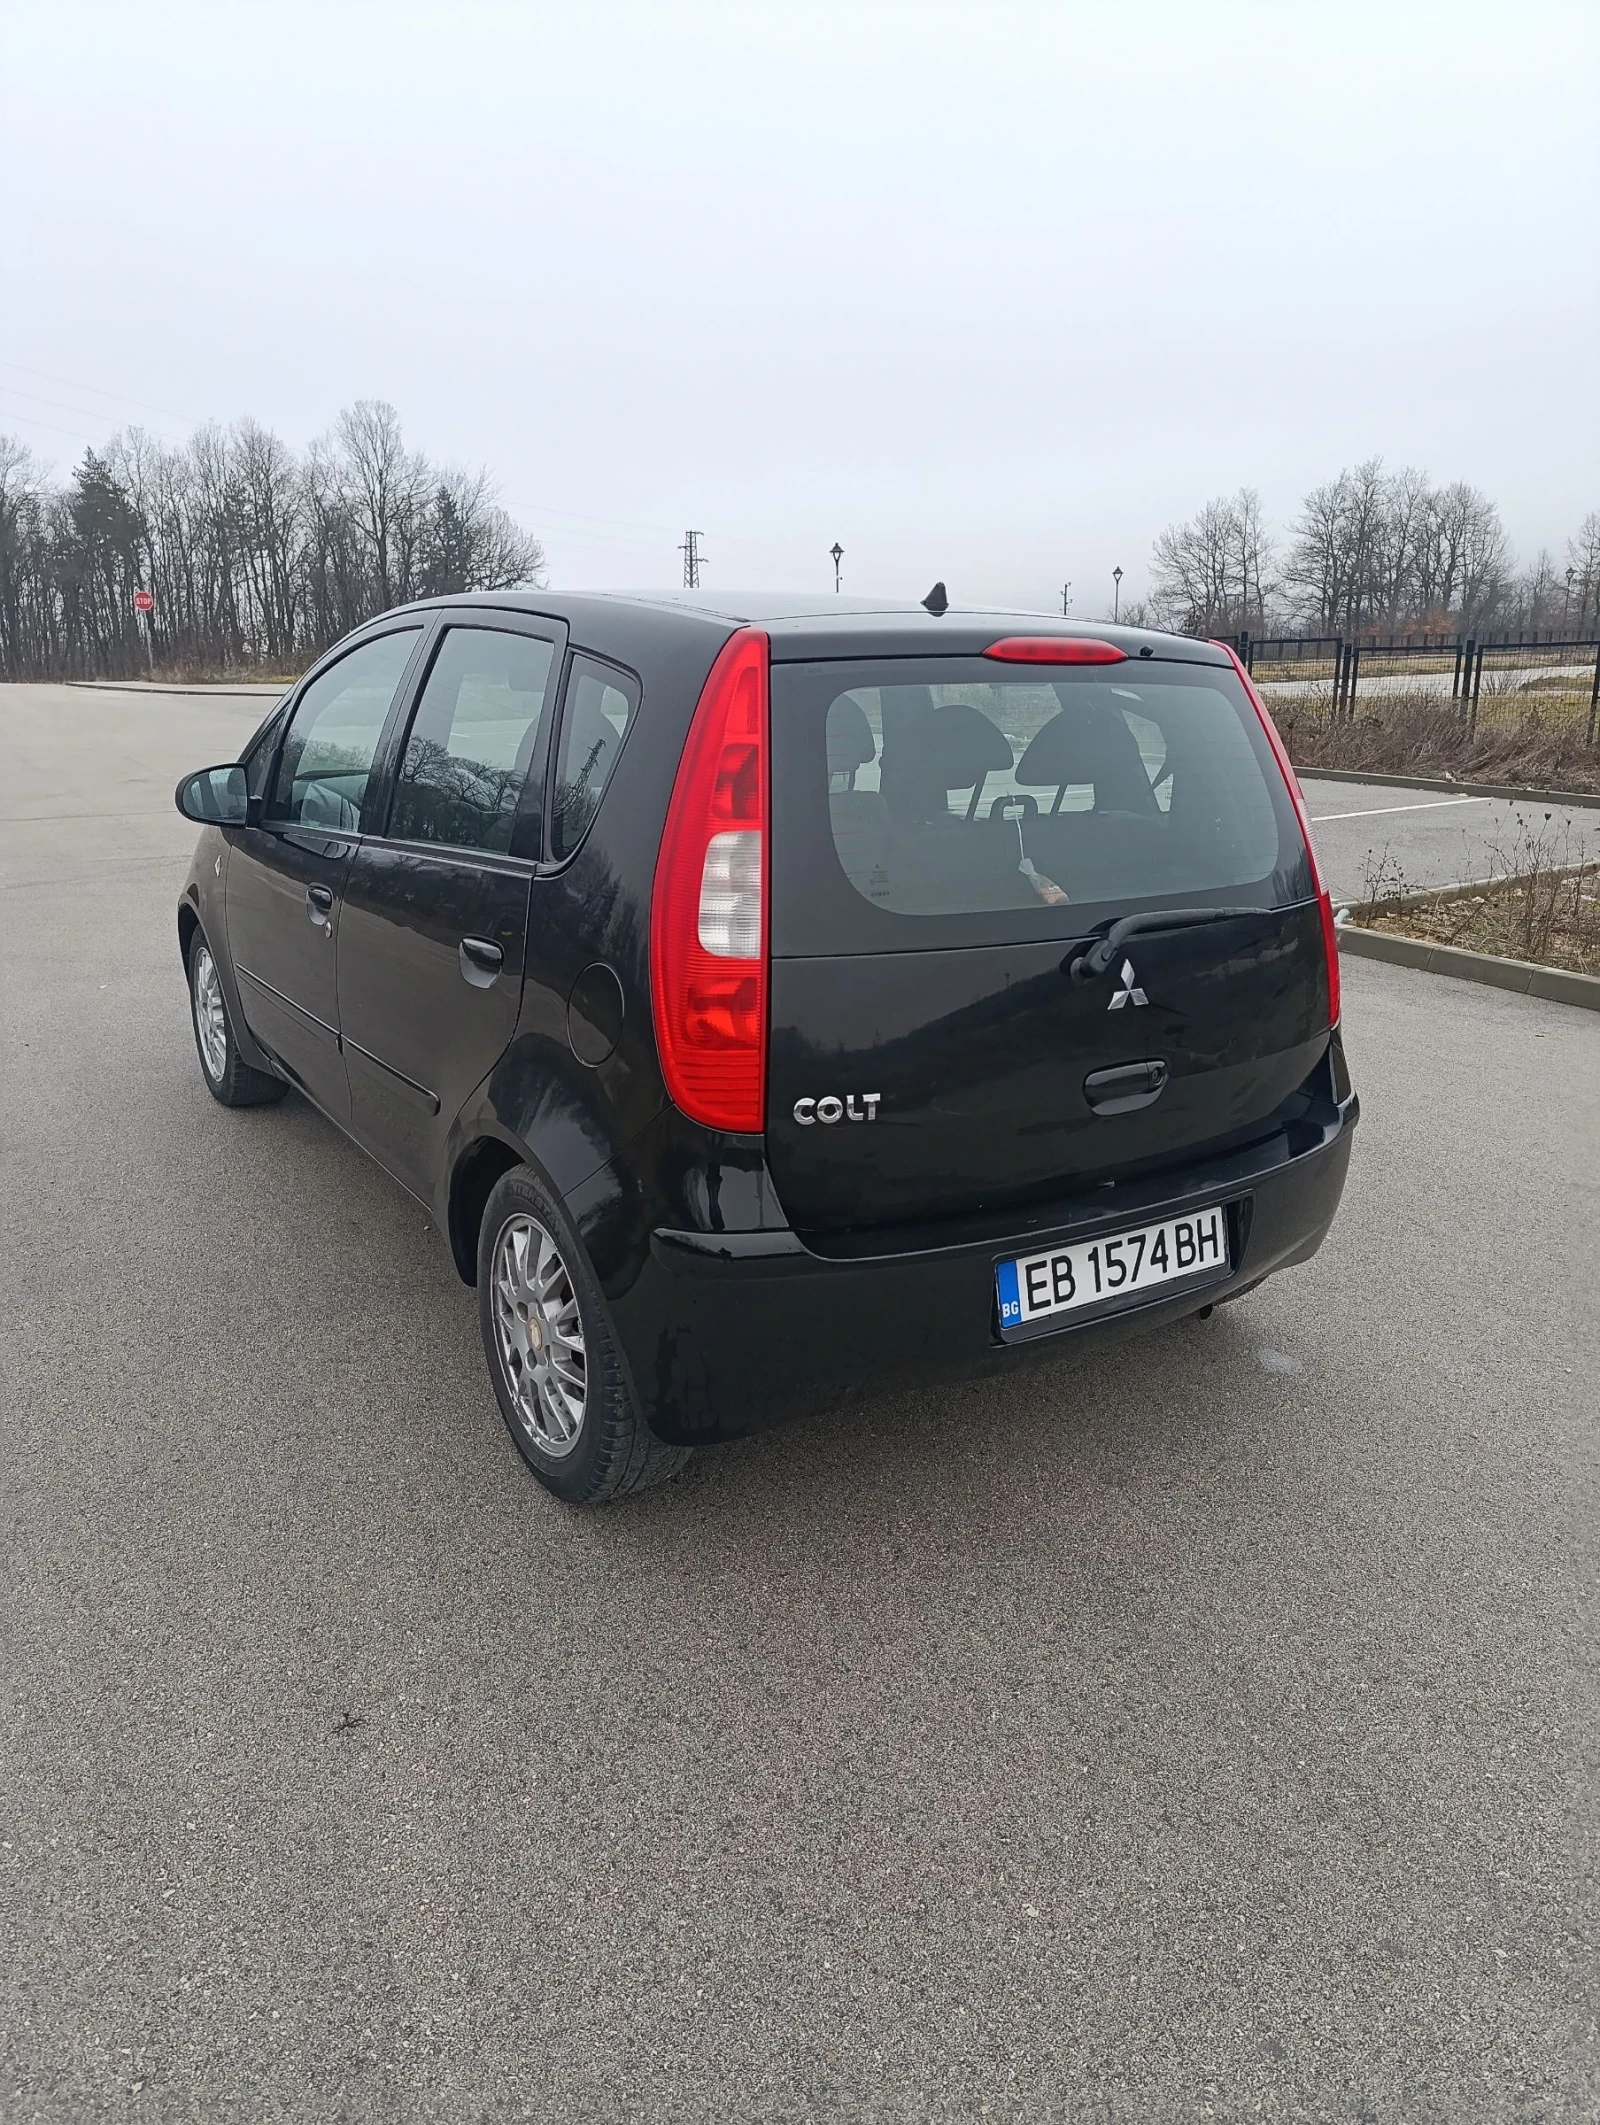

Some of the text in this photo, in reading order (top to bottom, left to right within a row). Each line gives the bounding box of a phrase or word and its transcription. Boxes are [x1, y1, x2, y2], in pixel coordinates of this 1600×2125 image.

[135, 597, 152, 605] STOP
[793, 1093, 881, 1125] COLT
[1025, 1214, 1219, 1312] EB 1574 BH
[1002, 1302, 1019, 1318] BG
